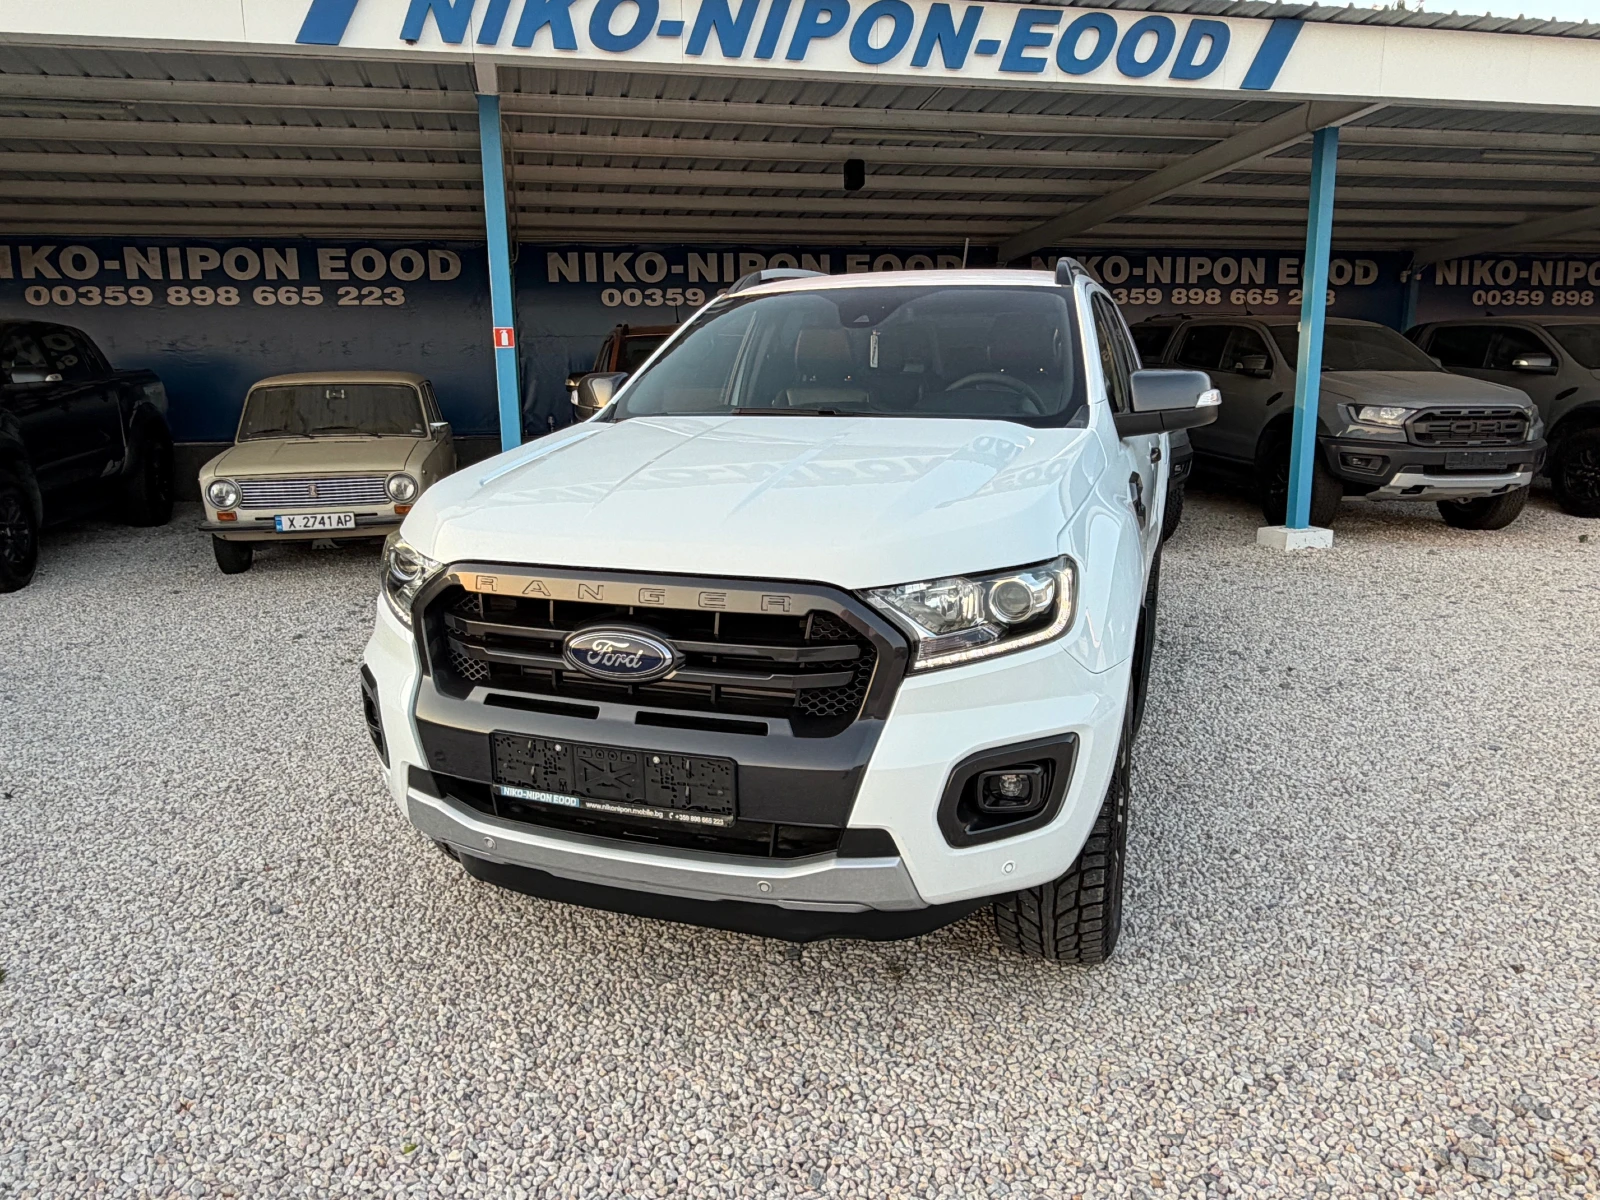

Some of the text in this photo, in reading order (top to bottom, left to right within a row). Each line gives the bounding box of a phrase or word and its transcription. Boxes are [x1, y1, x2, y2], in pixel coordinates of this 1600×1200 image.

[317, 248, 462, 281] EOOD
[1278, 257, 1379, 286] EOD
[25, 285, 406, 306] 00359 898 665 223
[601, 288, 706, 307] 00359
[1171, 288, 1221, 305] 898
[1230, 288, 1279, 305] 665
[1287, 289, 1336, 305] 23
[1472, 289, 1594, 306] 00359 898
[475, 574, 792, 612] RANGER
[587, 639, 643, 669] Ford
[503, 786, 577, 807] NIKO-NIPON EOOD
